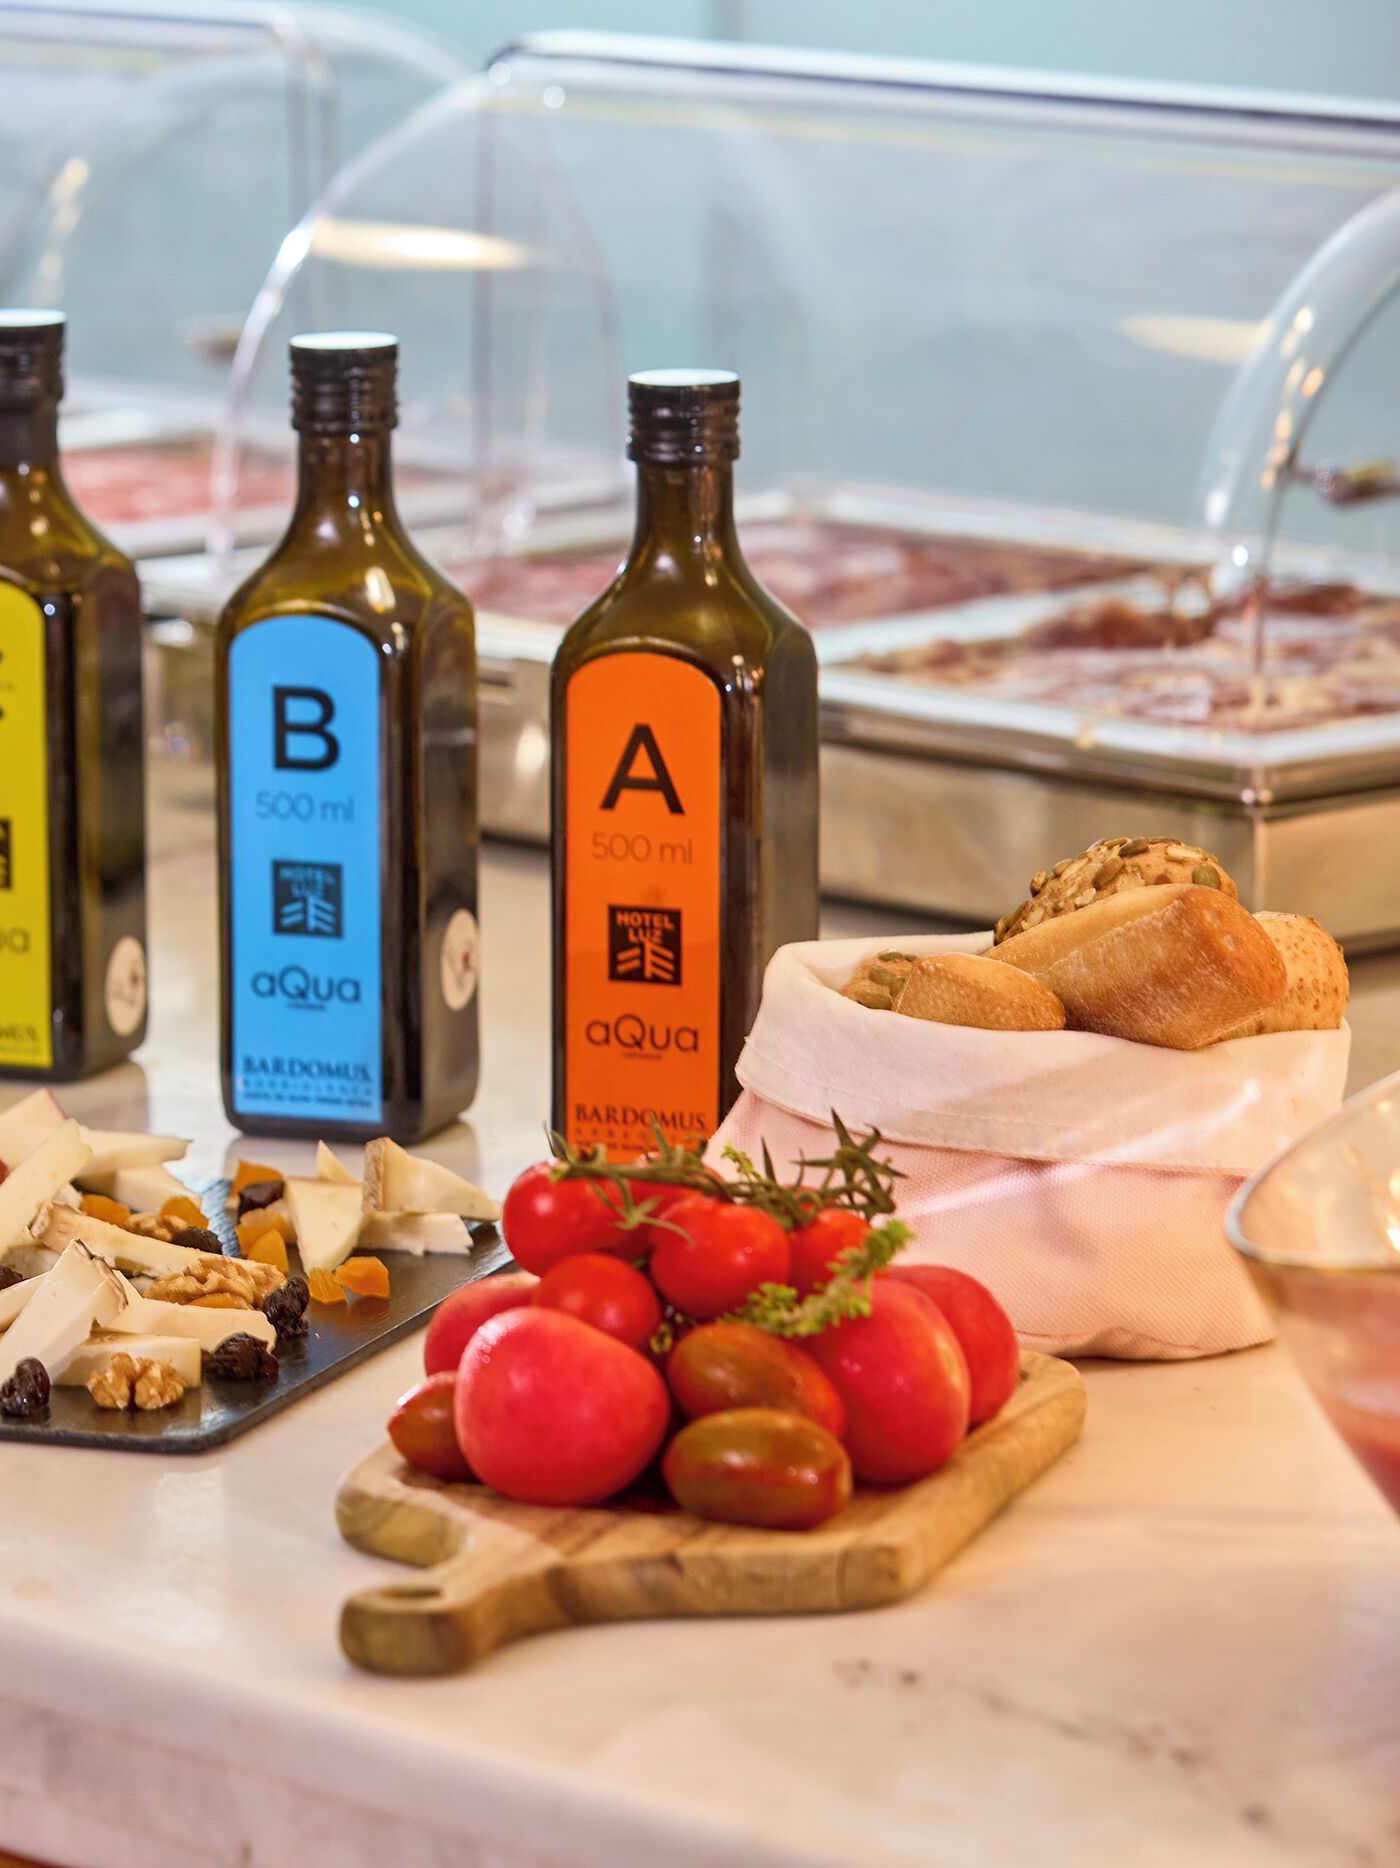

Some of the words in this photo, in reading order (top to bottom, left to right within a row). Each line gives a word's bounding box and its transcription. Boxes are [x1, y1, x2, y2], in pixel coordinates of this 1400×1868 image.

[272, 684, 340, 771] B
[600, 723, 685, 816] A
[255, 789, 314, 821] 500
[320, 796, 355, 822] ml
[591, 831, 651, 862] 500
[660, 838, 692, 865] ml
[616, 910, 675, 929] HOTEL
[627, 926, 664, 944] LUZ
[250, 963, 362, 1004] aQua
[586, 1013, 698, 1053] aQua
[243, 1055, 372, 1083] BARDOMUS
[575, 1102, 709, 1134] BARDOMUS
